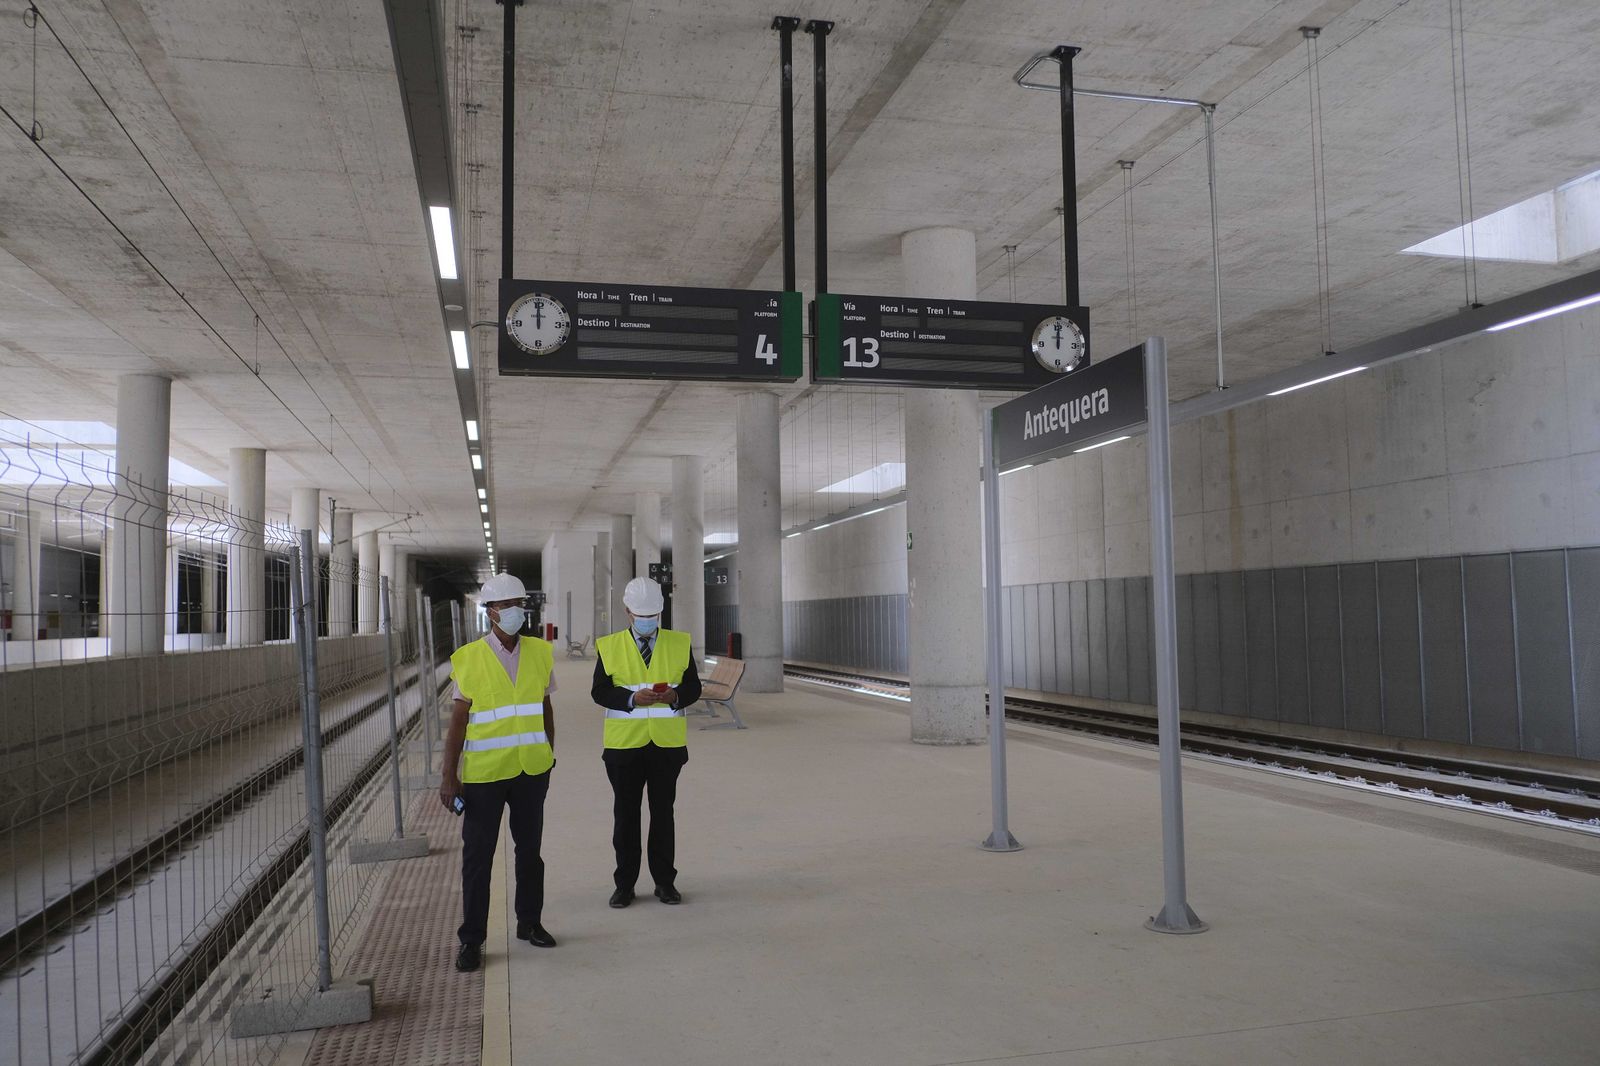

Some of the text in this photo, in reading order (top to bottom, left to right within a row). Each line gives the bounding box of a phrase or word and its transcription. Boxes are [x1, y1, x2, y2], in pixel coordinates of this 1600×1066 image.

[577, 290, 598, 299] Hora
[629, 293, 648, 301] Tren
[880, 304, 899, 313] Hora
[926, 306, 944, 315] Tren
[515, 320, 523, 328] 9
[554, 321, 562, 329] 3
[577, 318, 610, 327] Destino
[880, 330, 910, 339] Destino
[755, 334, 778, 365] 4
[843, 337, 880, 368] 13
[1023, 386, 1110, 441] Antequera
[716, 575, 728, 584] 13
